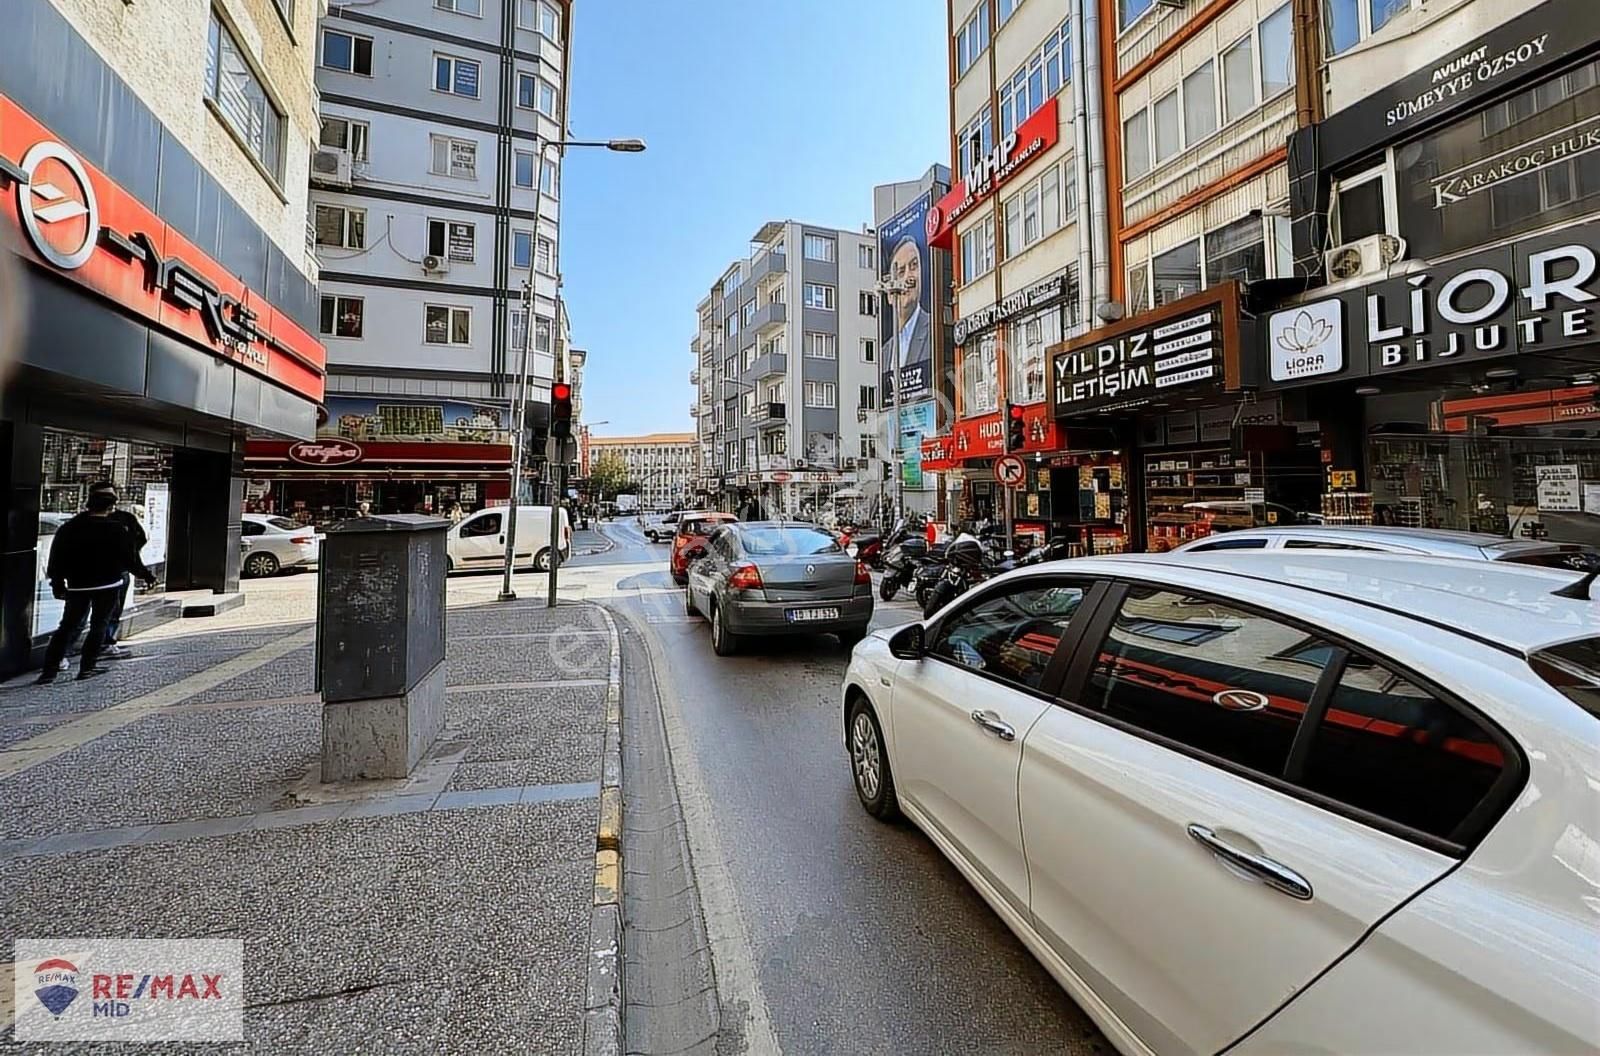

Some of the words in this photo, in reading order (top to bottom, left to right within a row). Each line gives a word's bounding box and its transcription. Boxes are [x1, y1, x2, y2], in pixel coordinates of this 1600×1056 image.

[1385, 73, 1473, 127] SÜMEYYE
[1476, 34, 1549, 82] ÖZSOY
[1431, 45, 1487, 83] AVUKAT
[963, 132, 1018, 197] MHP
[1431, 150, 1546, 210] KARAKOÇ
[1547, 129, 1600, 160] HUK
[1055, 333, 1149, 378] YILDIZ
[1056, 363, 1150, 405] İLETİŞİM
